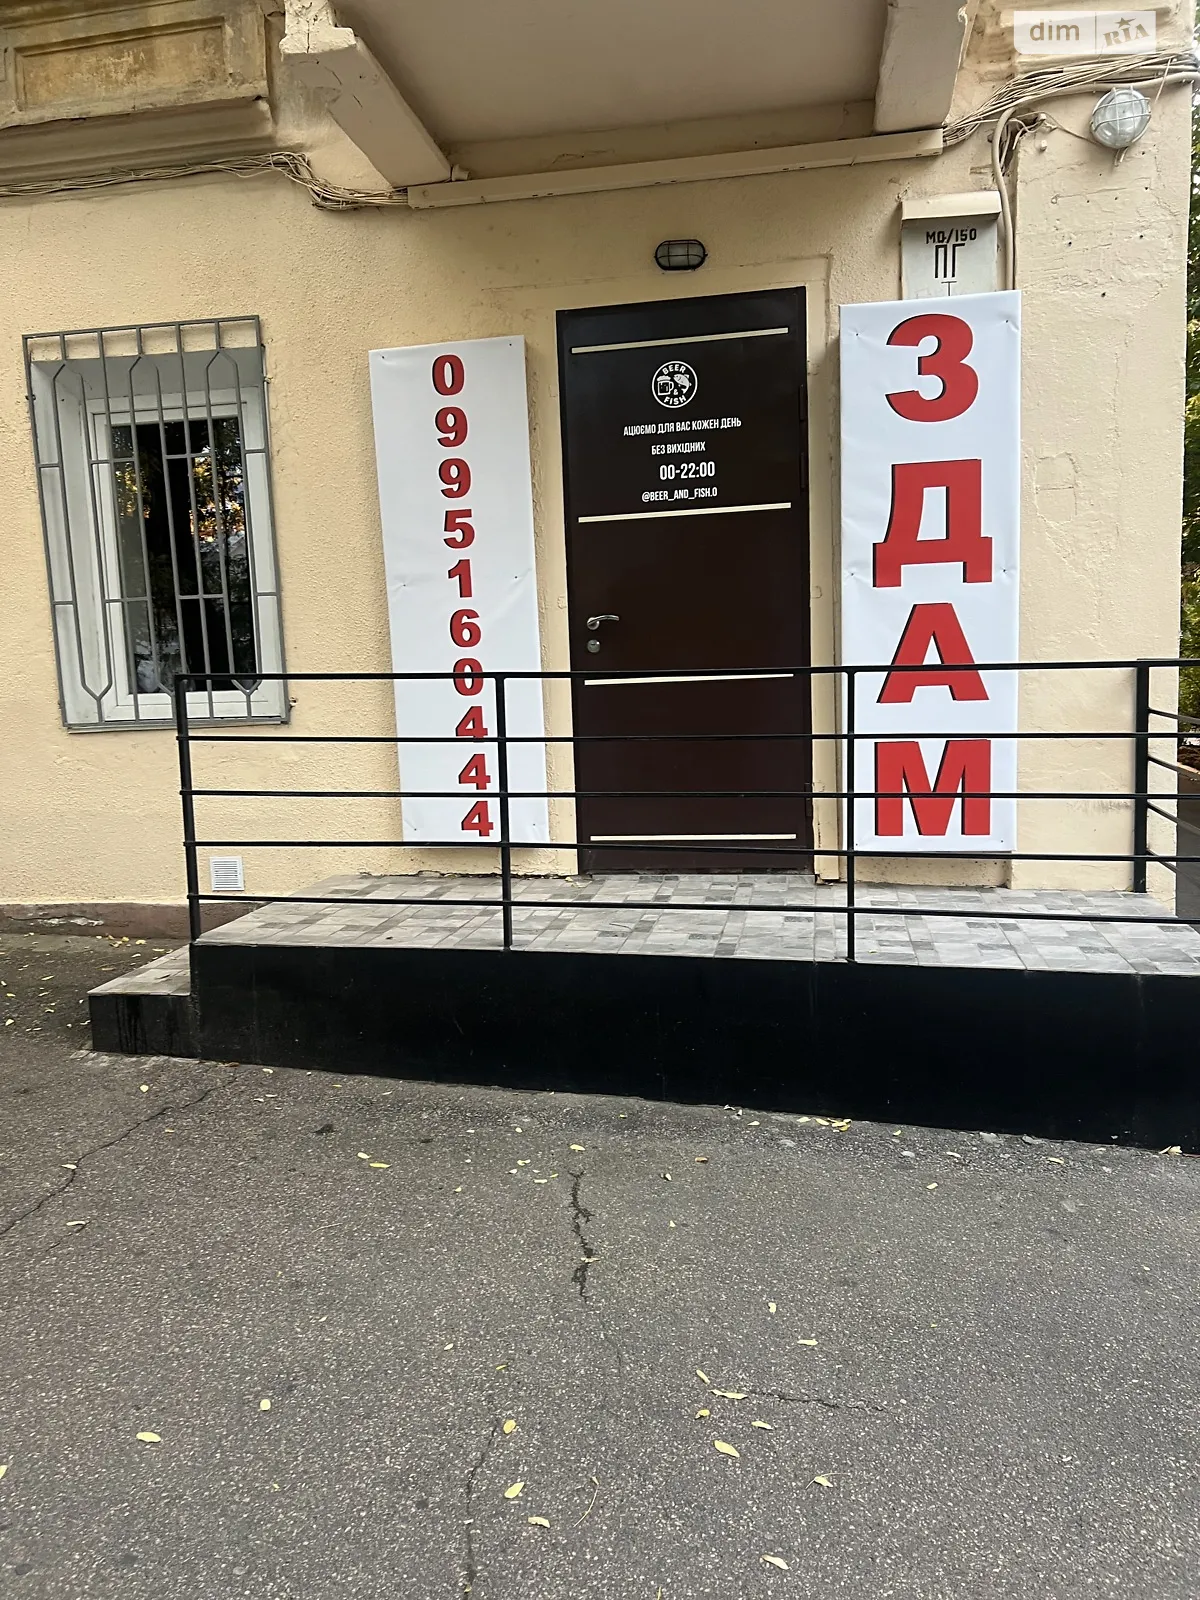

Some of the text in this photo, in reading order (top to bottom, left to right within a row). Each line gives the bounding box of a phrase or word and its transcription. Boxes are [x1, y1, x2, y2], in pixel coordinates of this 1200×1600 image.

[935, 243, 965, 278] ПГ
[662, 364, 686, 375] BEER
[664, 395, 687, 405] FISH
[657, 422, 675, 434] ДЛЯ
[675, 421, 691, 432] ВАС
[692, 419, 719, 431] КОЖЕН
[720, 417, 742, 429] ДЕНЬ
[651, 441, 706, 455] БЕЗ ВИХІДНИХ
[659, 461, 716, 480] 00-22:00
[872, 313, 993, 836] ЗДАМ
[432, 355, 494, 837] 0995160444
